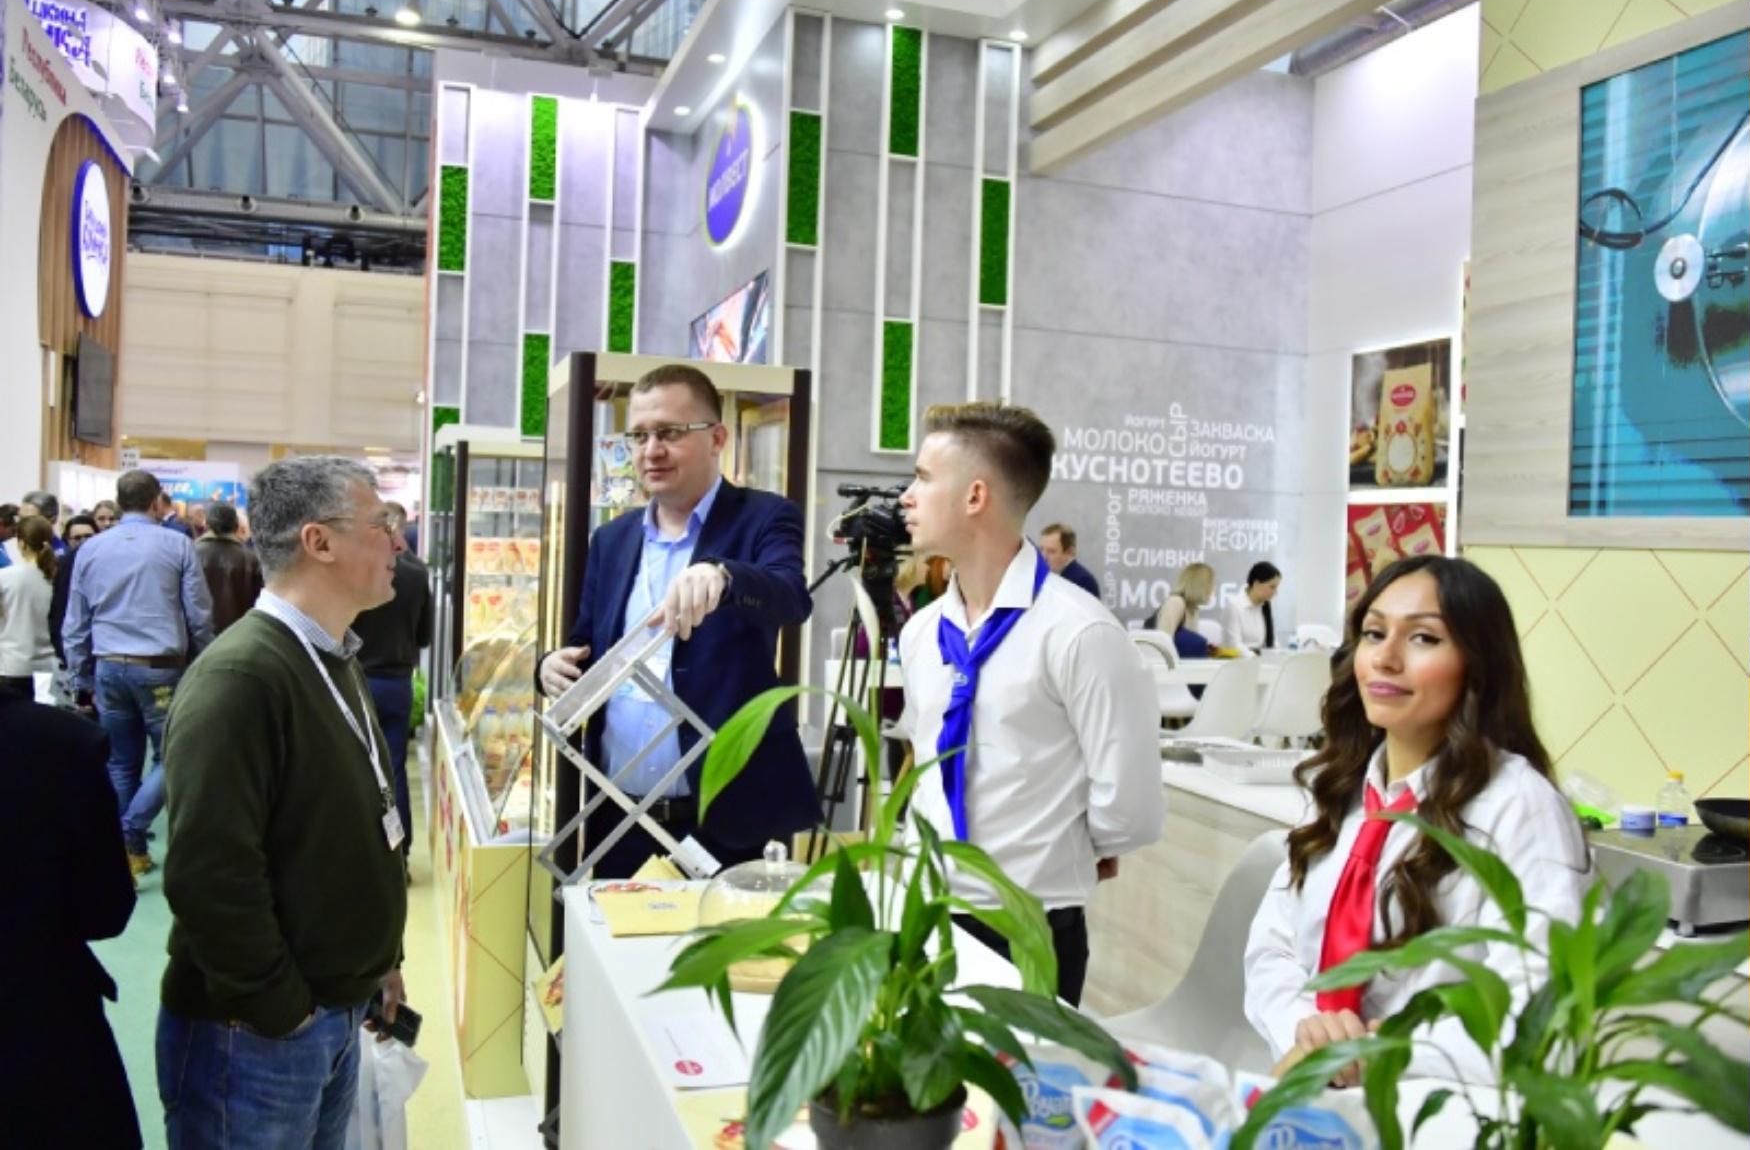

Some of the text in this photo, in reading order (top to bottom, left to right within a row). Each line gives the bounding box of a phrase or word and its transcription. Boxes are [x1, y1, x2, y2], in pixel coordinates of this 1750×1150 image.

[1063, 427, 1166, 455] МОЛОКО
[1168, 402, 1188, 458] СЫР
[1190, 419, 1276, 443] ЗАКВАСКА
[1190, 442, 1247, 460] ЙОГУРТ
[1051, 453, 1244, 490] КУСНОТЕЕВО
[1128, 487, 1207, 507] РЯЖЕНКА
[1105, 488, 1122, 566] ТВОРОГ
[1202, 529, 1279, 552] КЕФИР
[1123, 547, 1205, 568] СЛИВКИ
